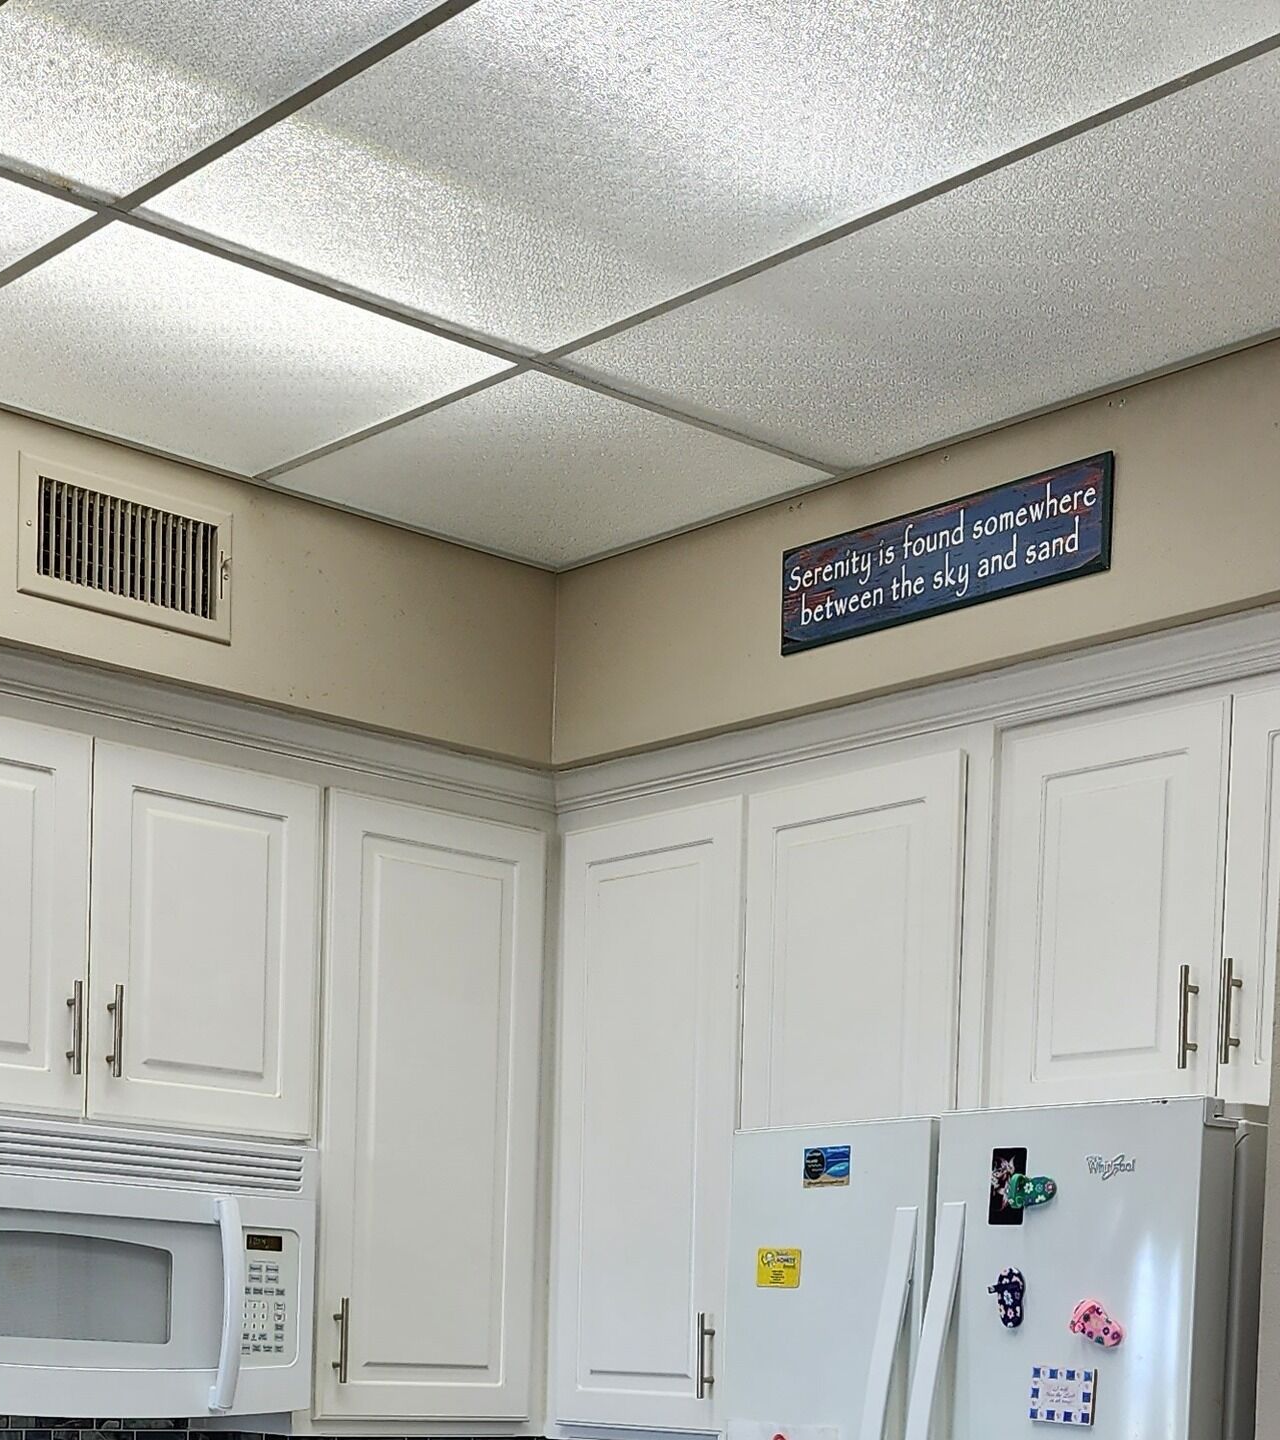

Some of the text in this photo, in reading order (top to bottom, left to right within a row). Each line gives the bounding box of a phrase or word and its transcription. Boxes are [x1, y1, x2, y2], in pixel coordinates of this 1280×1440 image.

[788, 482, 1098, 593] Serenity is found somewhere
[800, 515, 1080, 627] between the sky and sand
